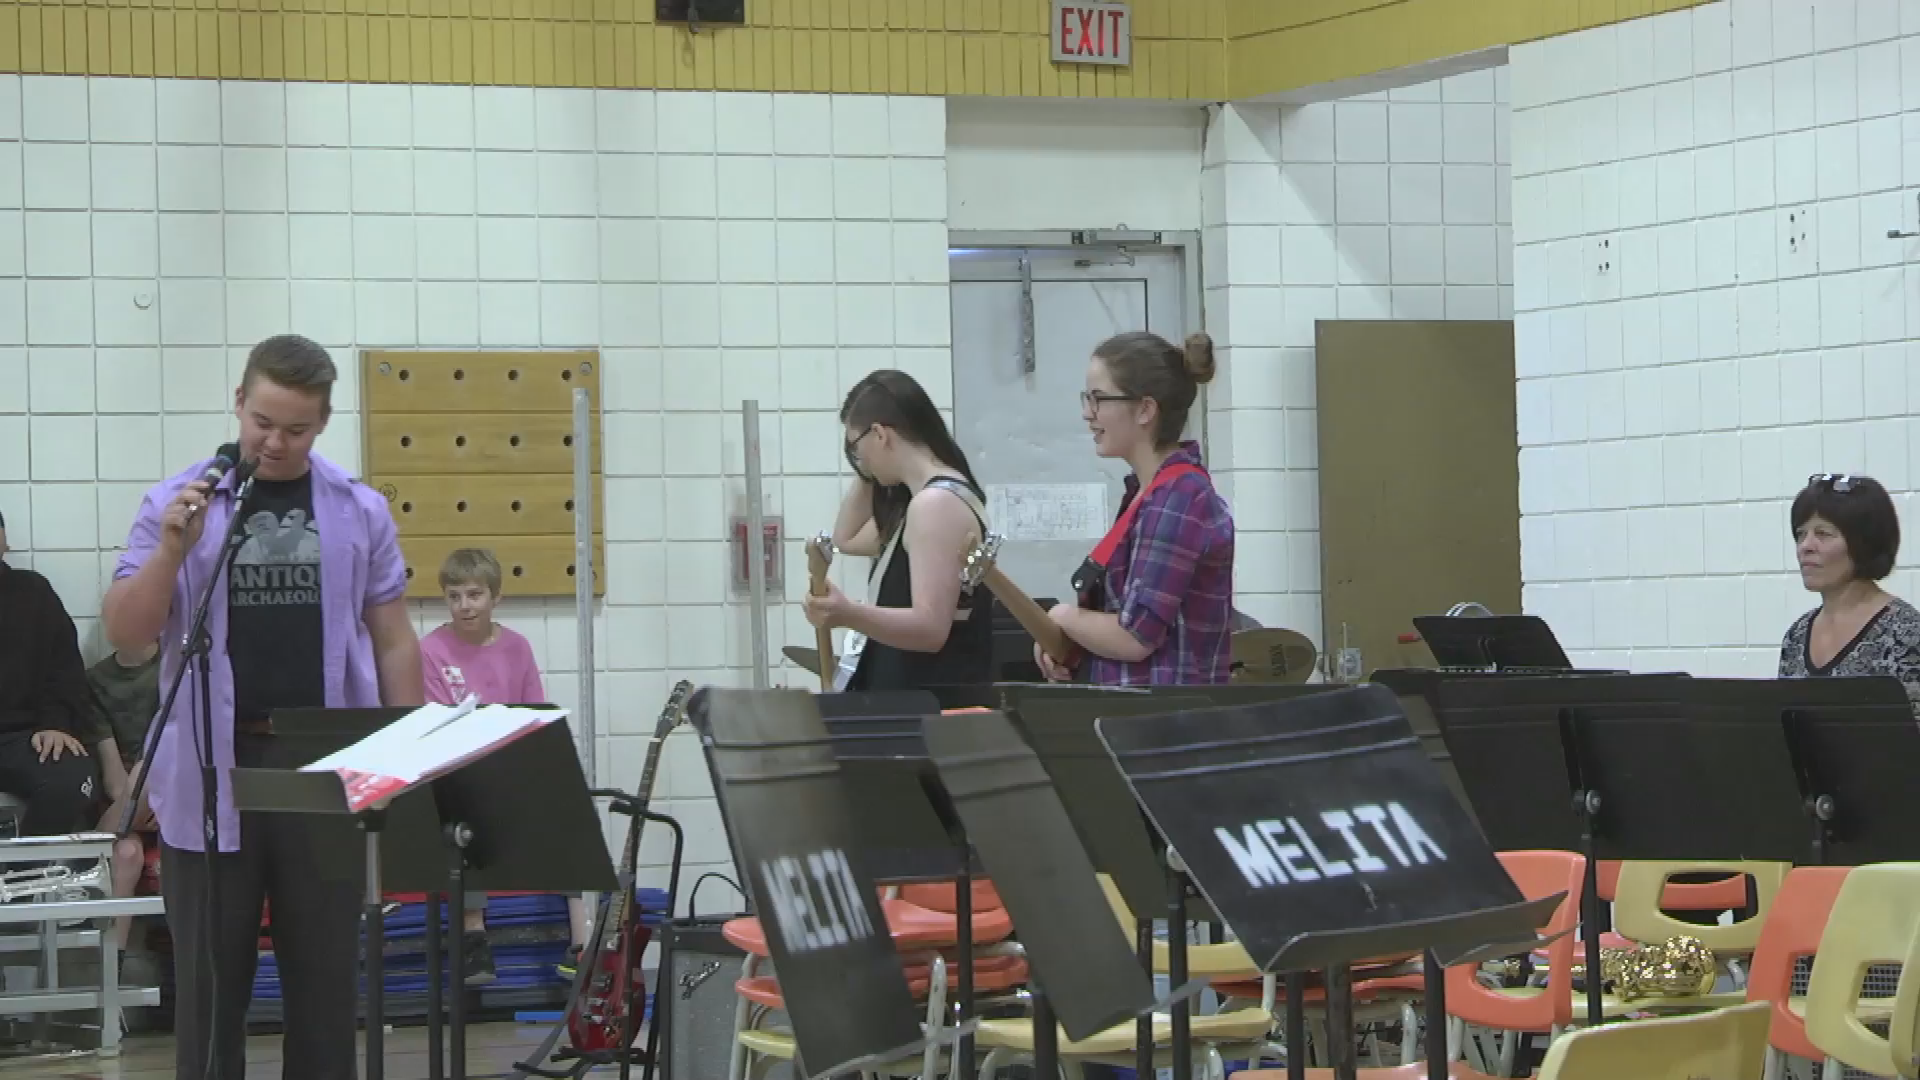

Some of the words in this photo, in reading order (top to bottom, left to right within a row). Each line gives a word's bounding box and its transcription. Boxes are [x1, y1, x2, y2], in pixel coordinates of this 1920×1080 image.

[1061, 7, 1124, 58] EXIT
[231, 565, 320, 590] ANTIQ
[1213, 801, 1447, 888] MELITA
[761, 848, 876, 953] MELITA
